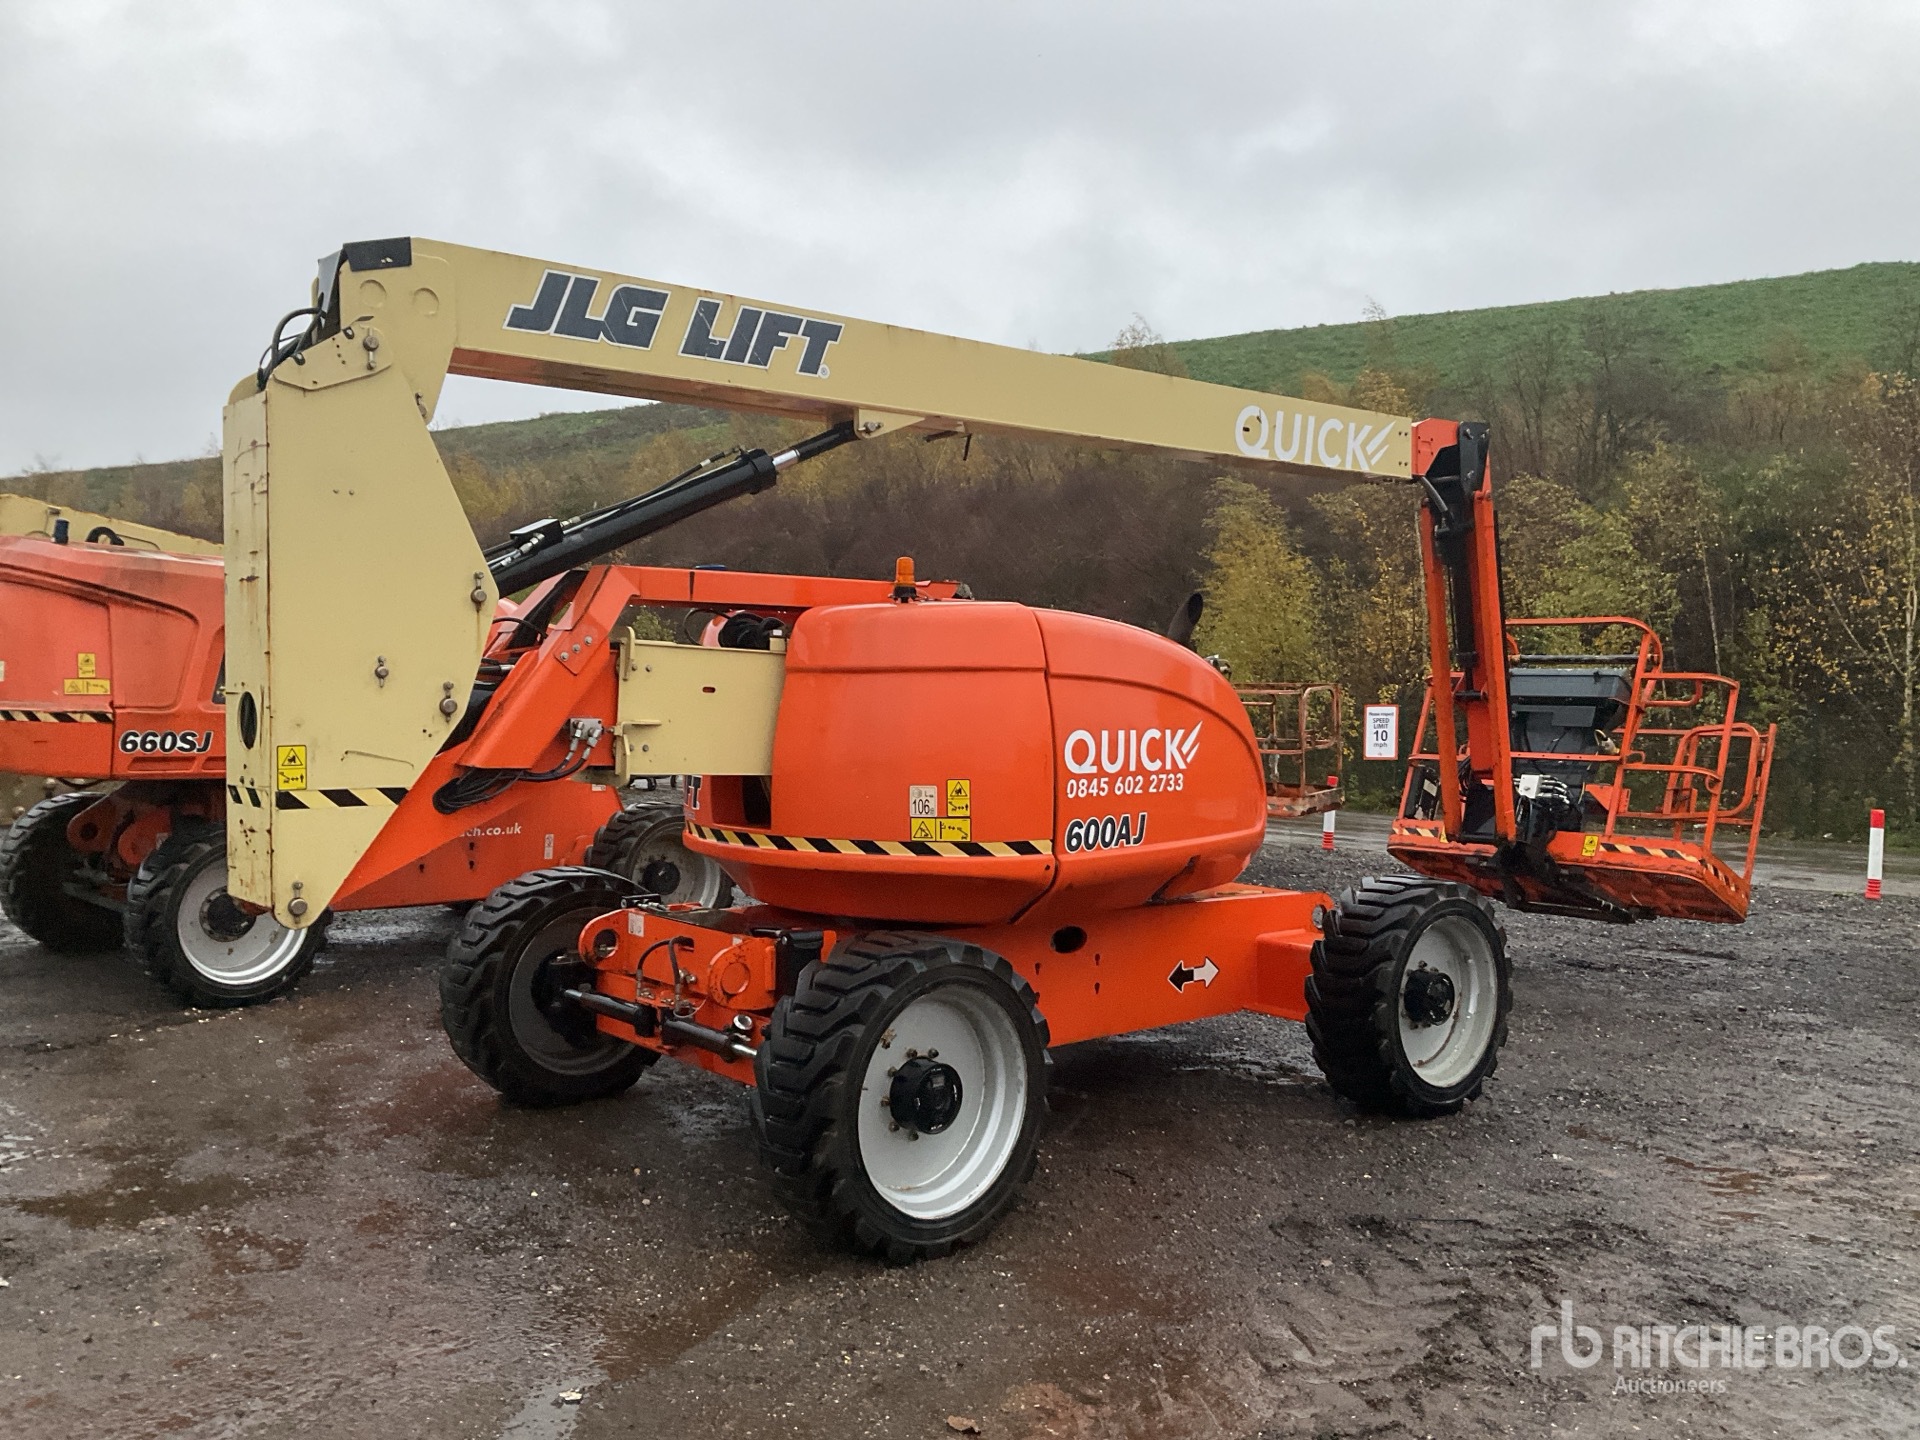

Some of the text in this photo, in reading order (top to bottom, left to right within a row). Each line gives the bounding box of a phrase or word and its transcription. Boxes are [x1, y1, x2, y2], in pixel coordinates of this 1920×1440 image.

[503, 269, 845, 378] JLG LIFT
[1235, 405, 1372, 473] QUICK
[119, 730, 214, 753] 660SJ
[1374, 730, 1388, 741] 10
[1064, 728, 1187, 774] QUICK
[1066, 773, 1184, 799] 0845 602 2733
[912, 799, 930, 815] 106
[461, 822, 522, 837] ch.co.uk
[1065, 812, 1147, 854] 600AJ
